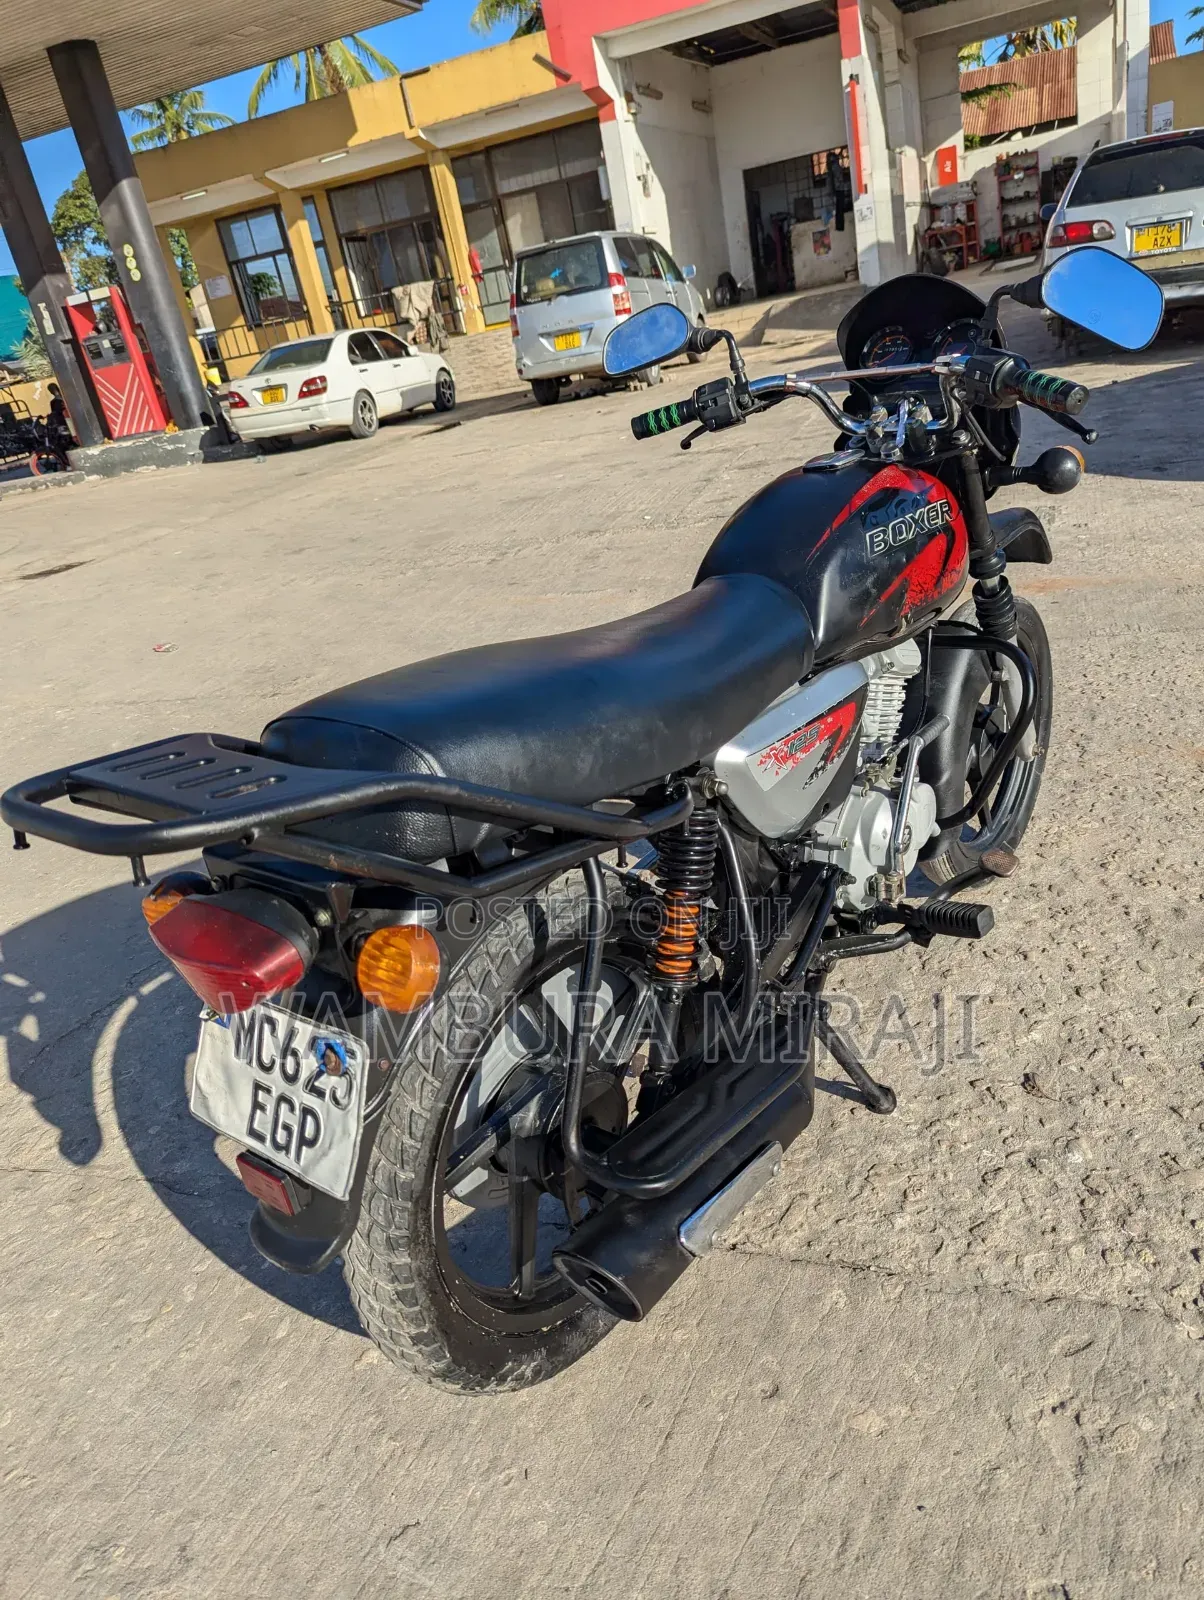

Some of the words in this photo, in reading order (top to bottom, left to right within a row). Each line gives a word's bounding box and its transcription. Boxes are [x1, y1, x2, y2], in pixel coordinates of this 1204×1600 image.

[944, 160, 952, 172] Air
[1152, 236, 1172, 248] AZX
[1151, 247, 1177, 255] TOYOTA
[866, 499, 953, 558] BOXER
[247, 1079, 324, 1166] EGP
